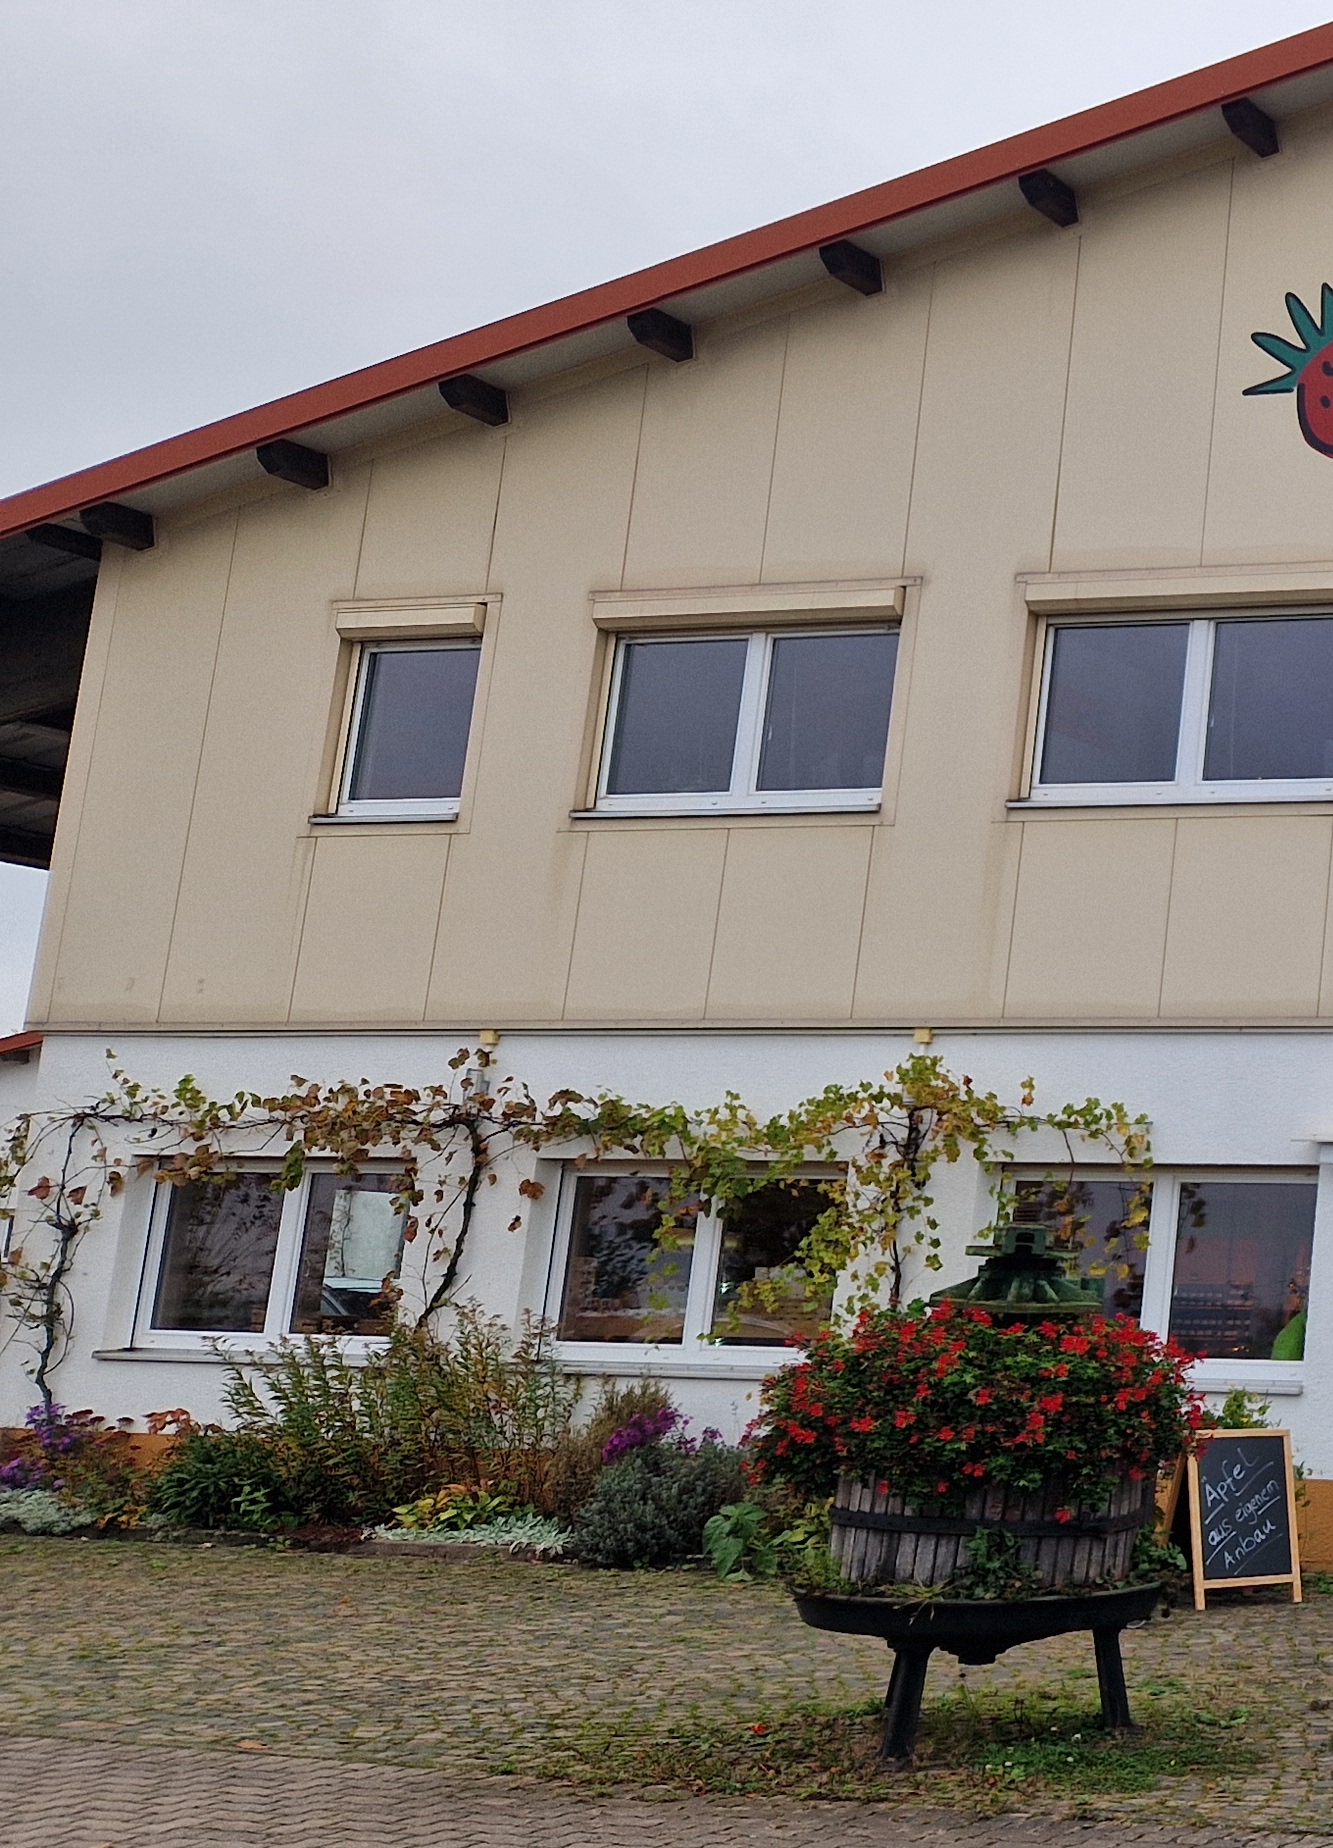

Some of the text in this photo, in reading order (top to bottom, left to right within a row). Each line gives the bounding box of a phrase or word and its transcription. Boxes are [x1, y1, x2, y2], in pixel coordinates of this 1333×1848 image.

[1200, 1448, 1259, 1507] Äpfel
[1208, 1480, 1279, 1545] aus eigenem
[1224, 1520, 1276, 1569] Anbau
